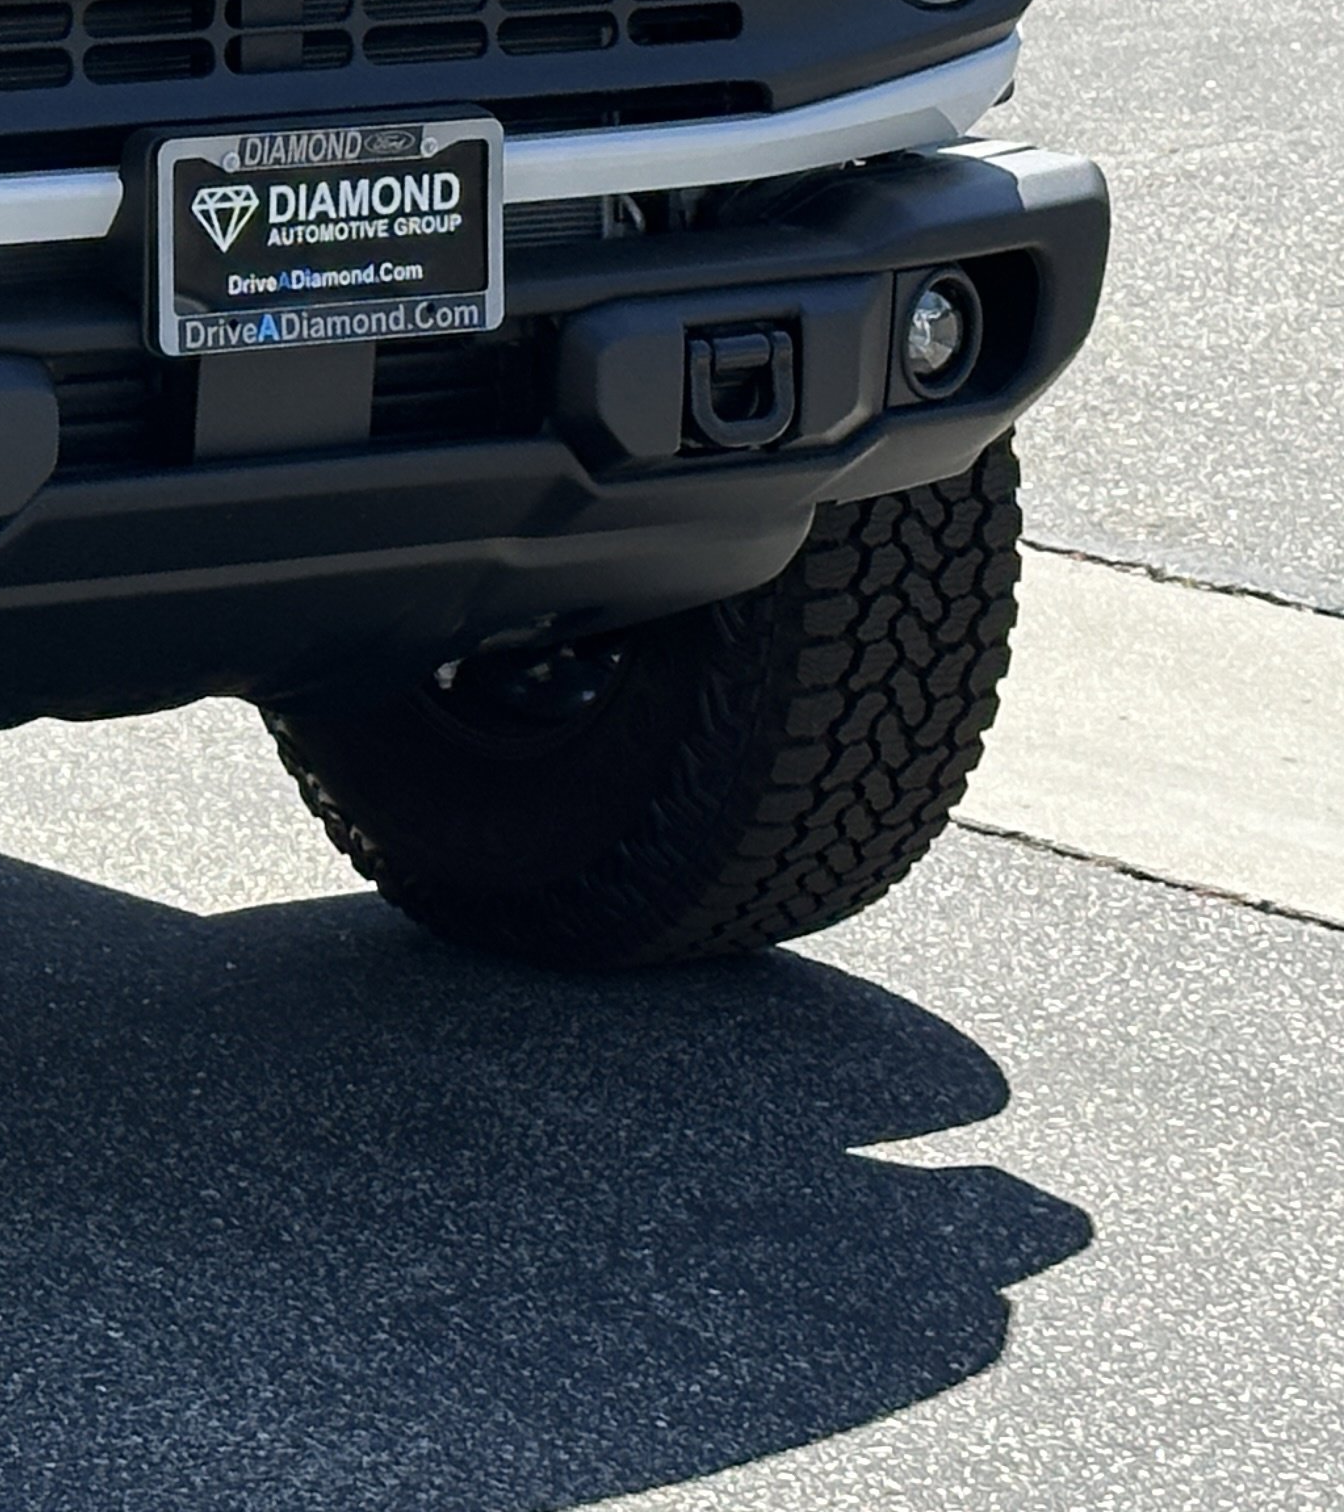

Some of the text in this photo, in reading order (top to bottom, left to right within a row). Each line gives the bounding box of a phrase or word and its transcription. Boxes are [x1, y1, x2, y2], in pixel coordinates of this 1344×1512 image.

[244, 131, 362, 167] DIAMOND
[268, 172, 460, 224] DIAMOND
[267, 213, 462, 247] AUTOMOTIVE GROUP
[228, 260, 424, 296] DriveADiamond.Com
[184, 301, 480, 349] DriveADiamond.Com
